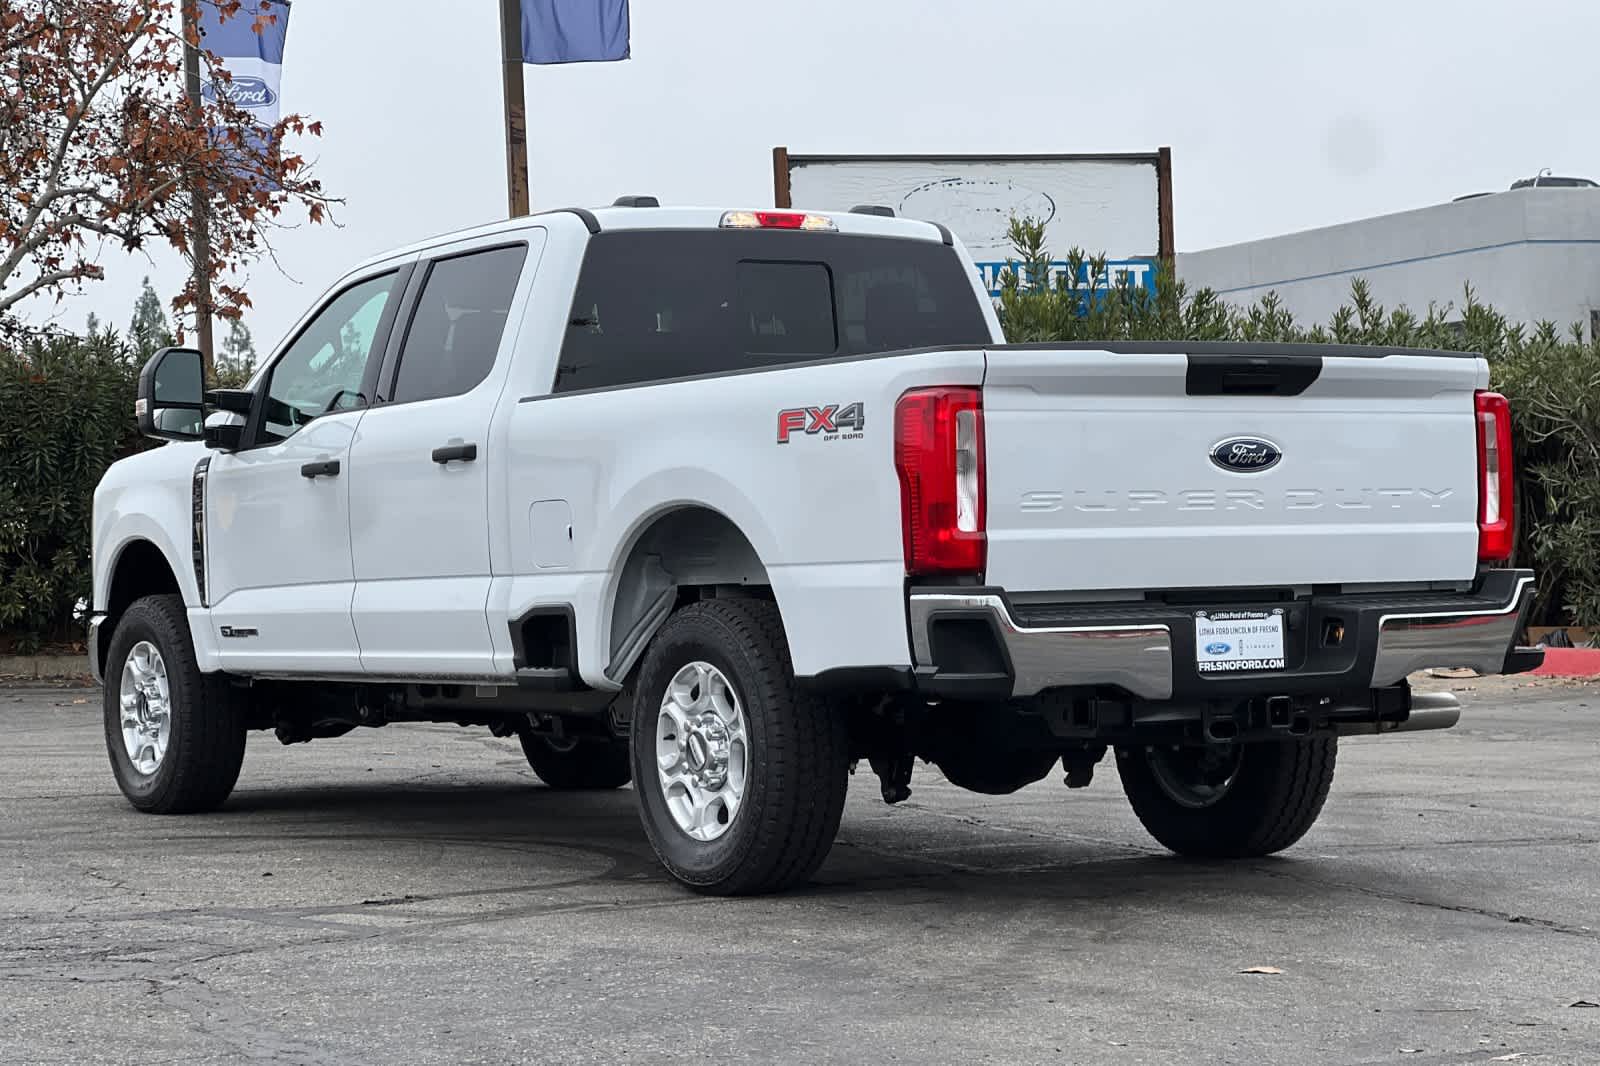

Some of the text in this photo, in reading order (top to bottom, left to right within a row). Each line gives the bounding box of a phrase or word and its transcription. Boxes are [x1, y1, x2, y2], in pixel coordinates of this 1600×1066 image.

[222, 82, 267, 102] Ford
[777, 402, 864, 444] FX4
[1228, 443, 1267, 463] Ford
[1020, 487, 1455, 513] SUPER DUTY
[1199, 627, 1215, 636] LITHIA
[1216, 627, 1230, 635] FORD
[1230, 626, 1252, 635] LINCOLN
[1259, 625, 1279, 633] FRESNO
[1199, 659, 1285, 671] FRESNOFORD.COM
